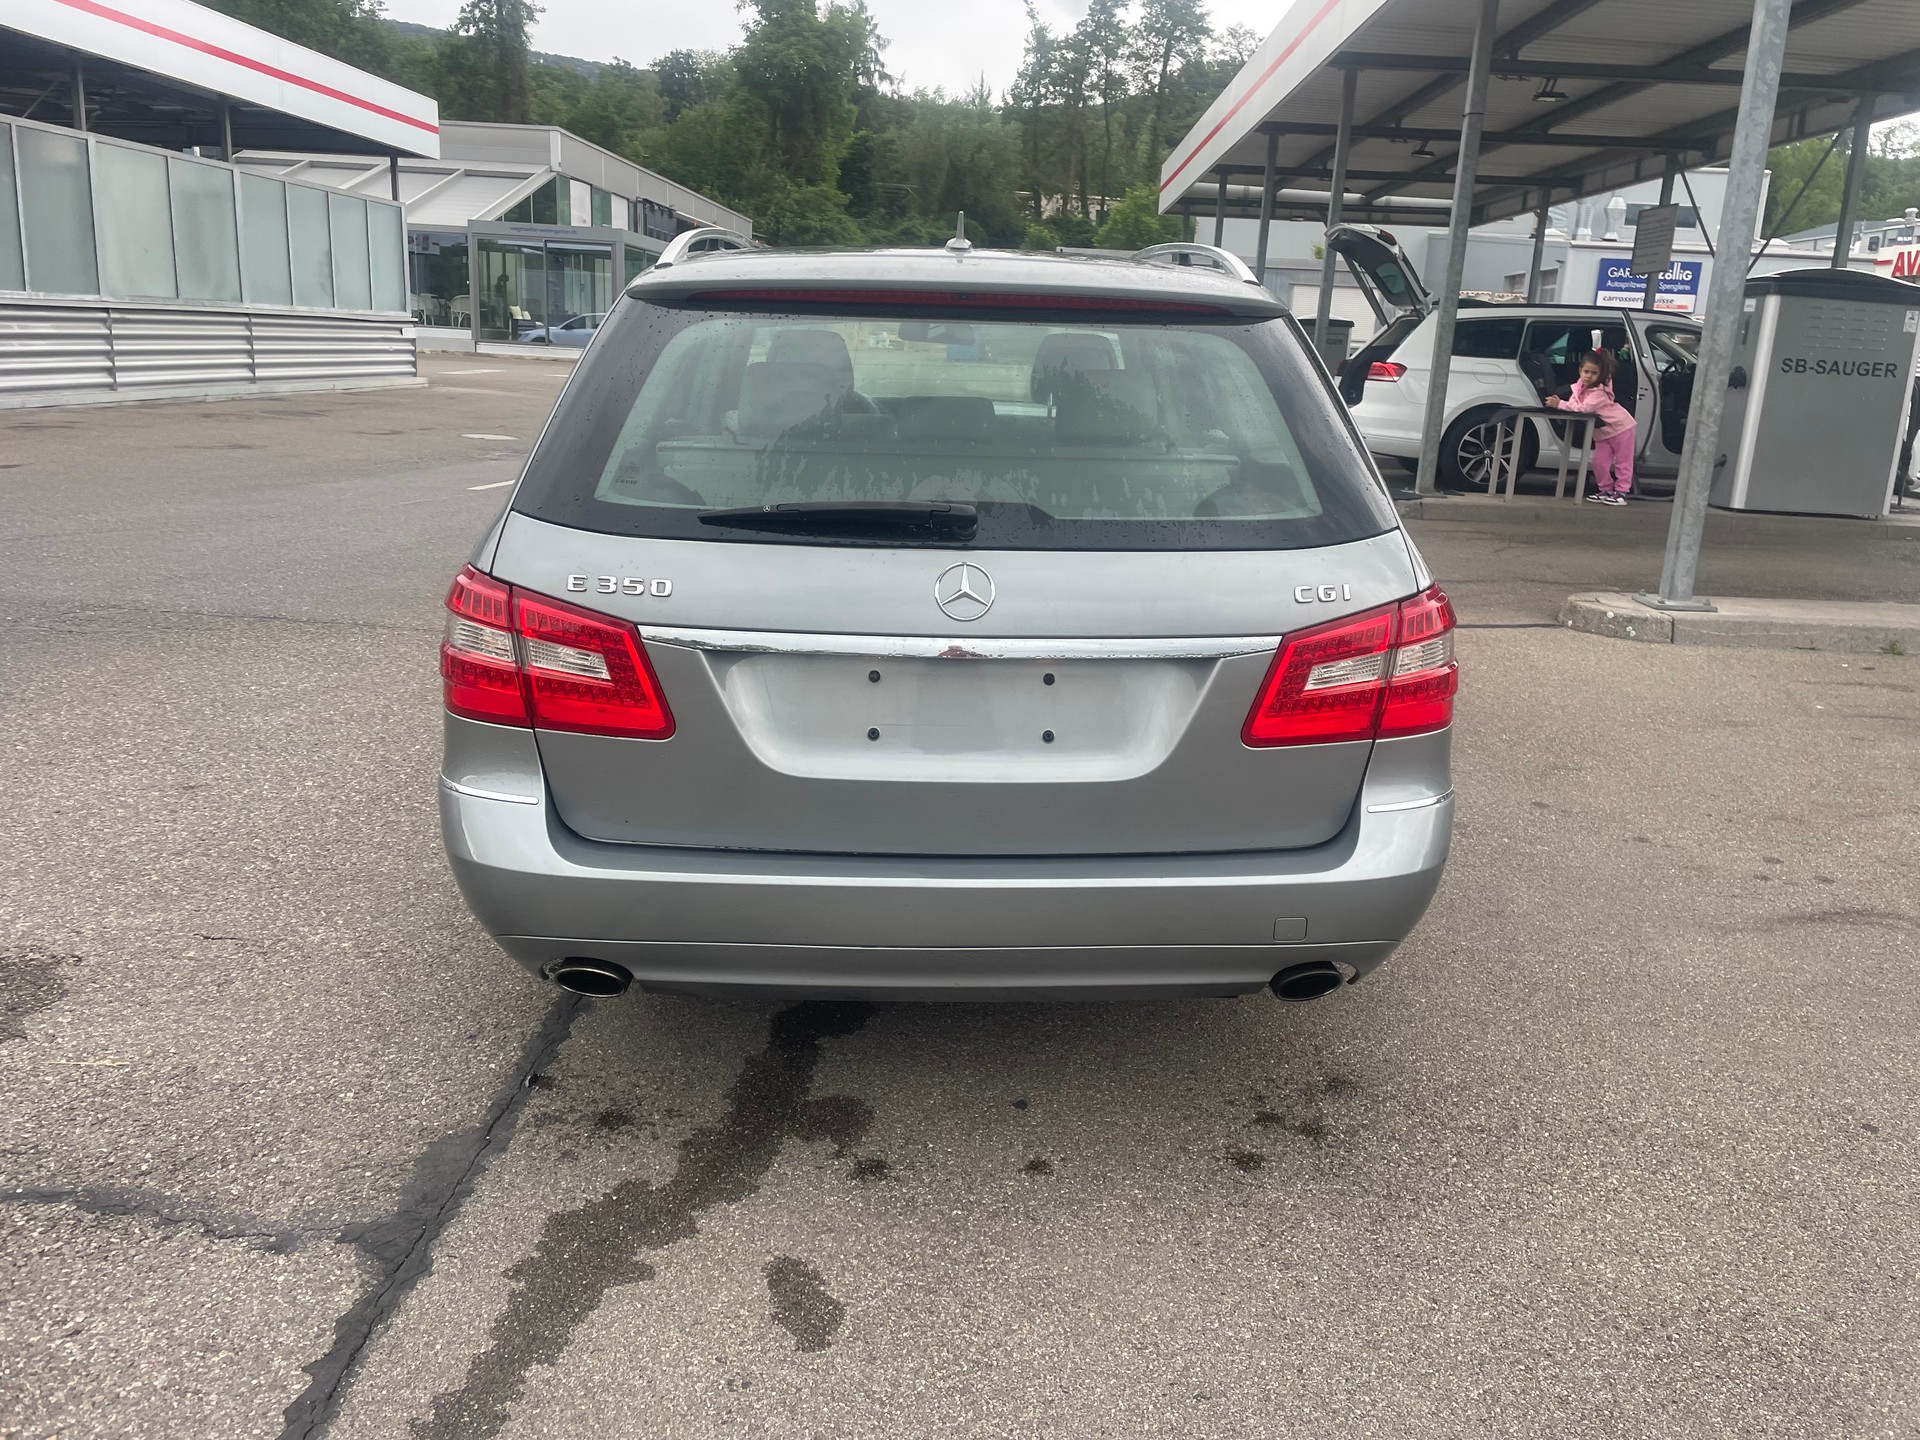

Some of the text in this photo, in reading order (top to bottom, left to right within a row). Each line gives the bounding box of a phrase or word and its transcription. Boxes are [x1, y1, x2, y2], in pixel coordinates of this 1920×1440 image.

[1891, 250, 1920, 278] AV
[1658, 281, 1691, 292] Spenglerei
[1602, 295, 1645, 304] carrosseri
[1781, 357, 1898, 378] SB-SAUGER
[567, 574, 673, 597] E 350
[1294, 583, 1351, 604] CGI
